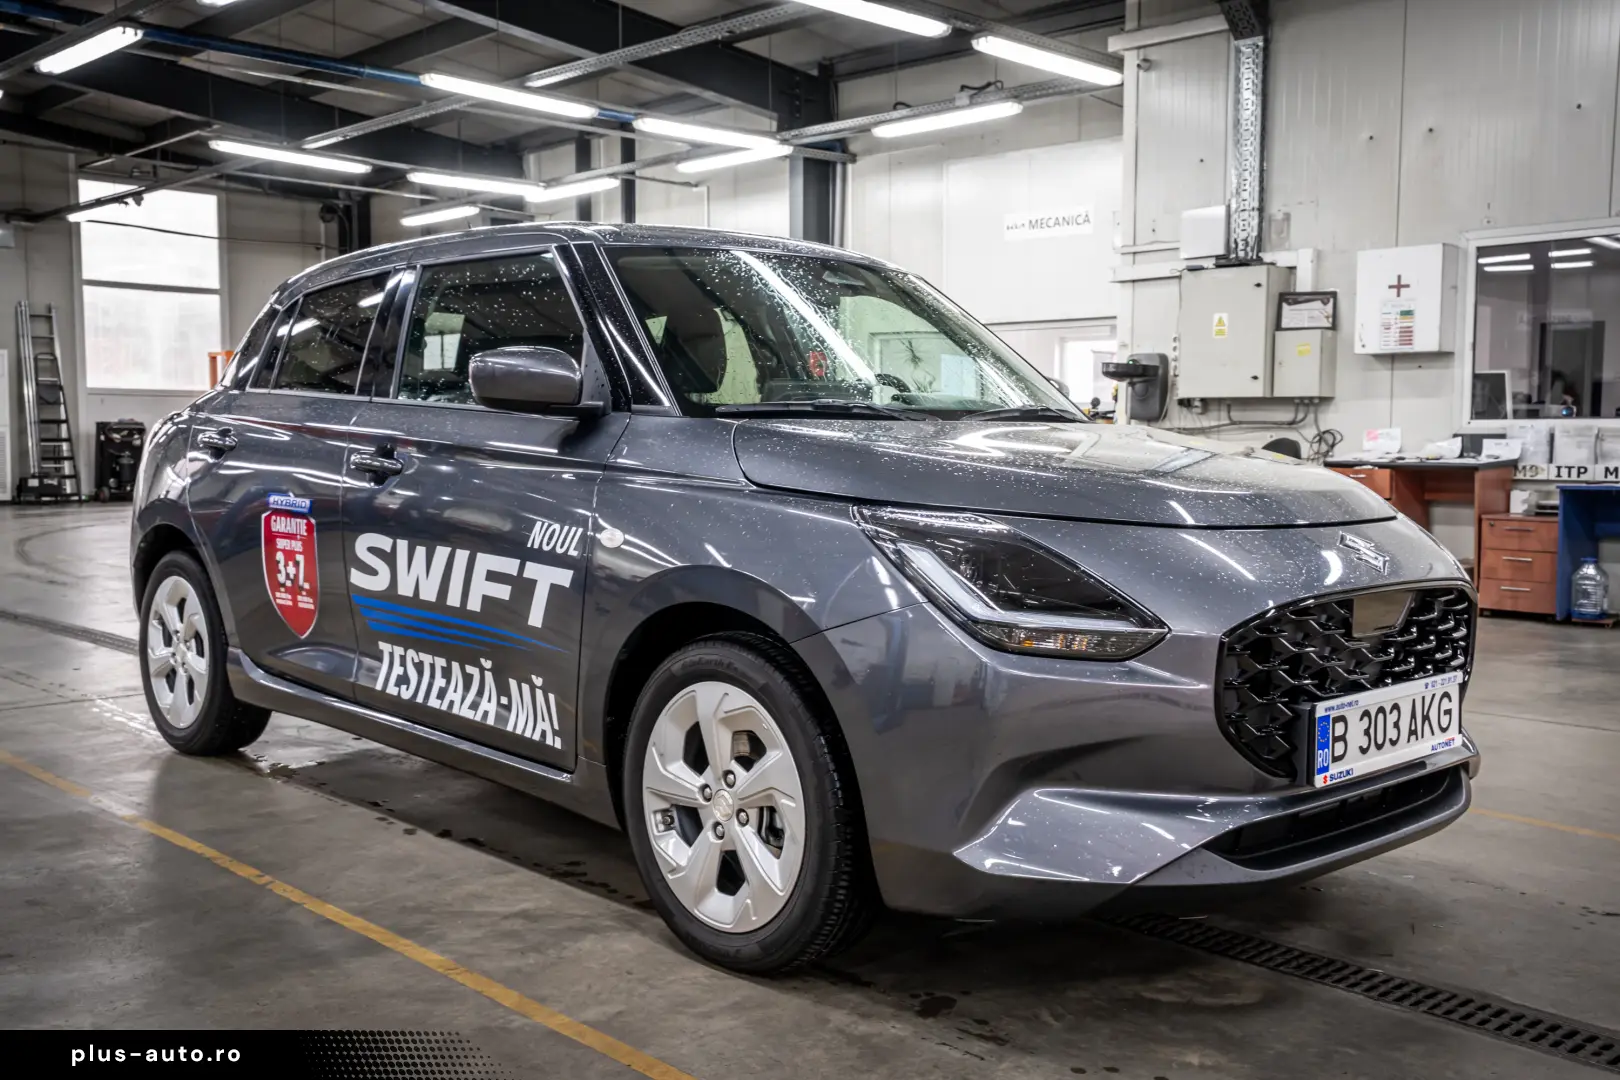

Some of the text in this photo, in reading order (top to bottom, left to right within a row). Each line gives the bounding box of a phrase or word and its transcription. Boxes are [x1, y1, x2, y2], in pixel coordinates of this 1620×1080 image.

[1555, 465, 1588, 479] ITP
[272, 497, 307, 509] HYBRID
[271, 515, 308, 536] GARANTIE
[527, 521, 583, 556] NOUL
[350, 532, 574, 628] SWIFT
[375, 640, 562, 750] TESTEAZĂ-MĂ!
[1331, 690, 1453, 764] B 303 AKG
[1430, 737, 1456, 752] AUTONET
[1317, 748, 1329, 769] RO
[1329, 767, 1354, 782] SUZUKI
